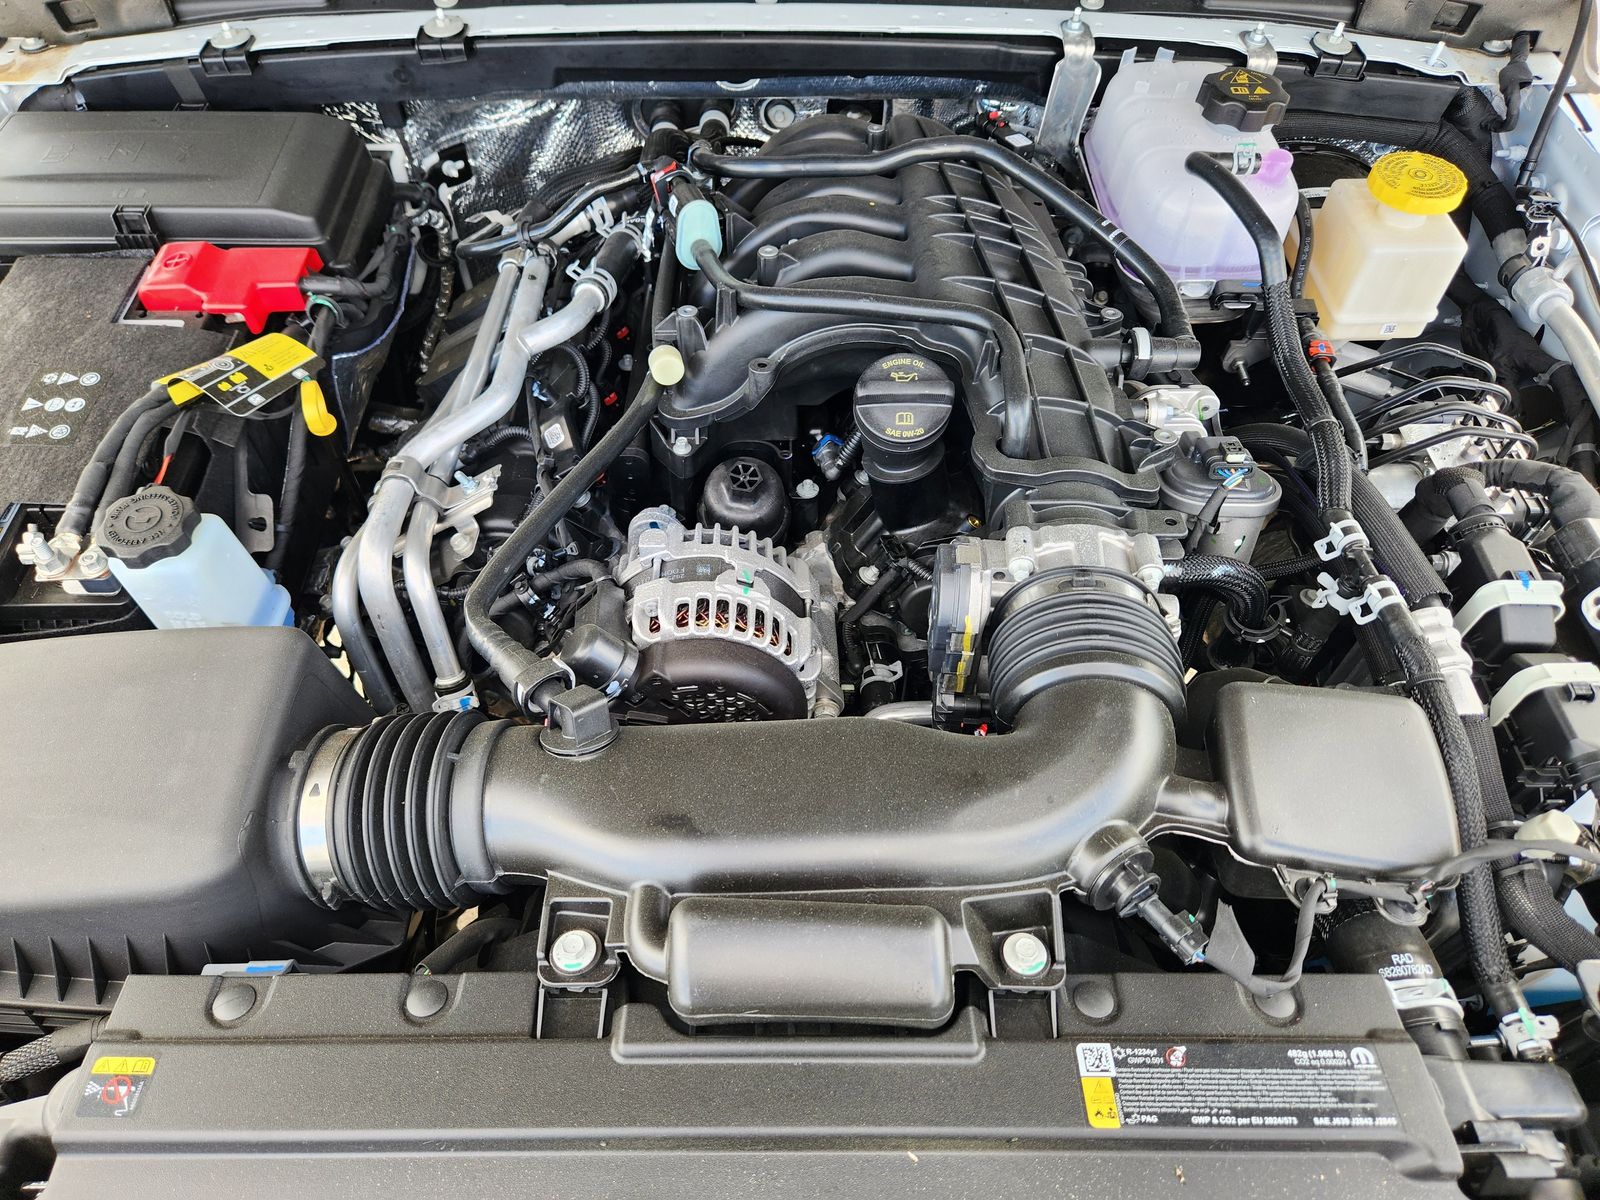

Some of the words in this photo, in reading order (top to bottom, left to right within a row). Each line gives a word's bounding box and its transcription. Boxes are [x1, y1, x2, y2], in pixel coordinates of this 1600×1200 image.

[882, 358, 912, 369] ENGINE
[912, 359, 925, 369] OIL
[885, 427, 902, 437] SAE
[902, 427, 925, 438] 0W-20
[1391, 952, 1413, 965] RAD
[1128, 1056, 1144, 1064] GWP
[1294, 1058, 1310, 1066] CO2
[1141, 1114, 1159, 1124] PAG
[1191, 1115, 1211, 1125] GWP
[1211, 1116, 1219, 1125] &
[1219, 1115, 1237, 1125] CO2
[1237, 1117, 1251, 1126] per
[1251, 1116, 1263, 1126] EU
[1313, 1117, 1331, 1126] SAE
